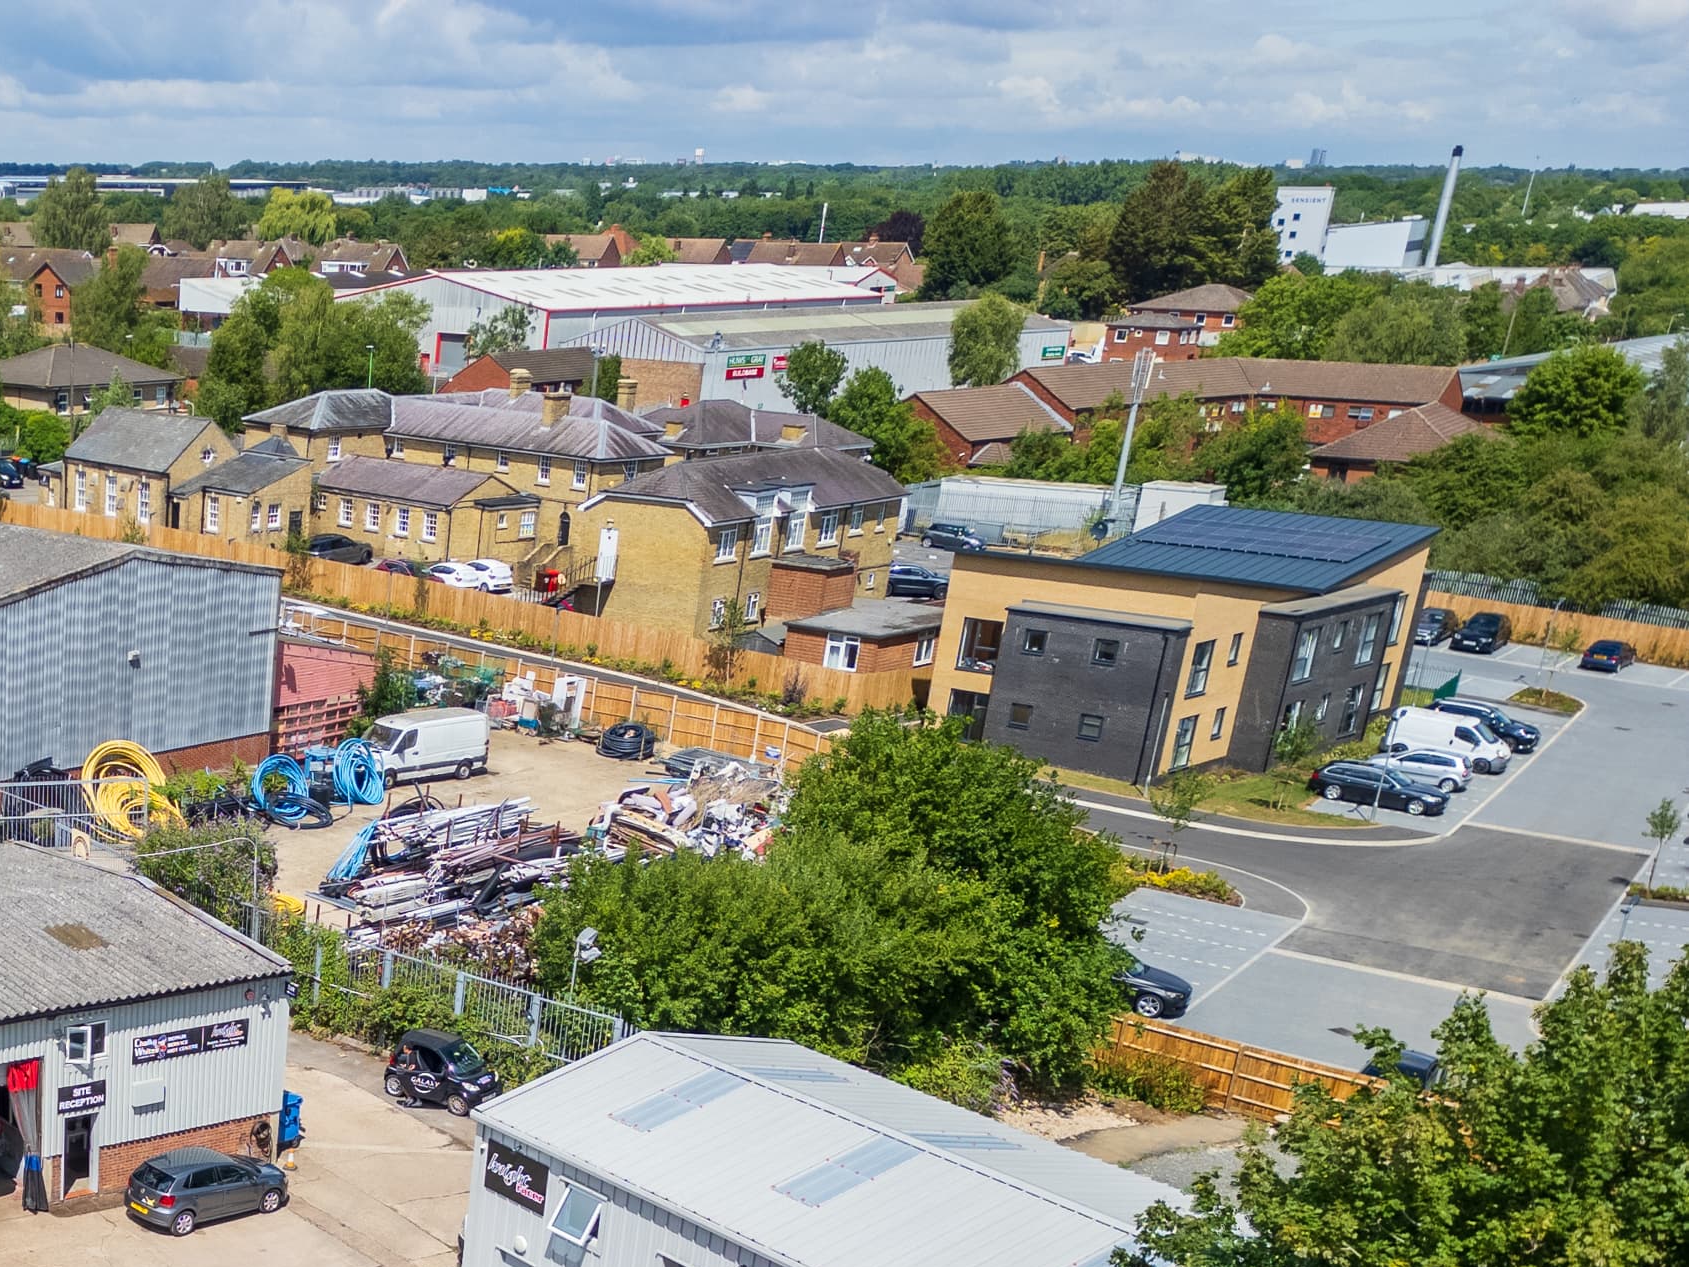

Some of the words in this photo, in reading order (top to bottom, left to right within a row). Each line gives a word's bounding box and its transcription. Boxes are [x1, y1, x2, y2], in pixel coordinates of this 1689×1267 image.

[410, 1075, 441, 1089] GALAXY
[72, 1086, 92, 1097] SITE
[59, 1094, 104, 1110] RECEPTION
